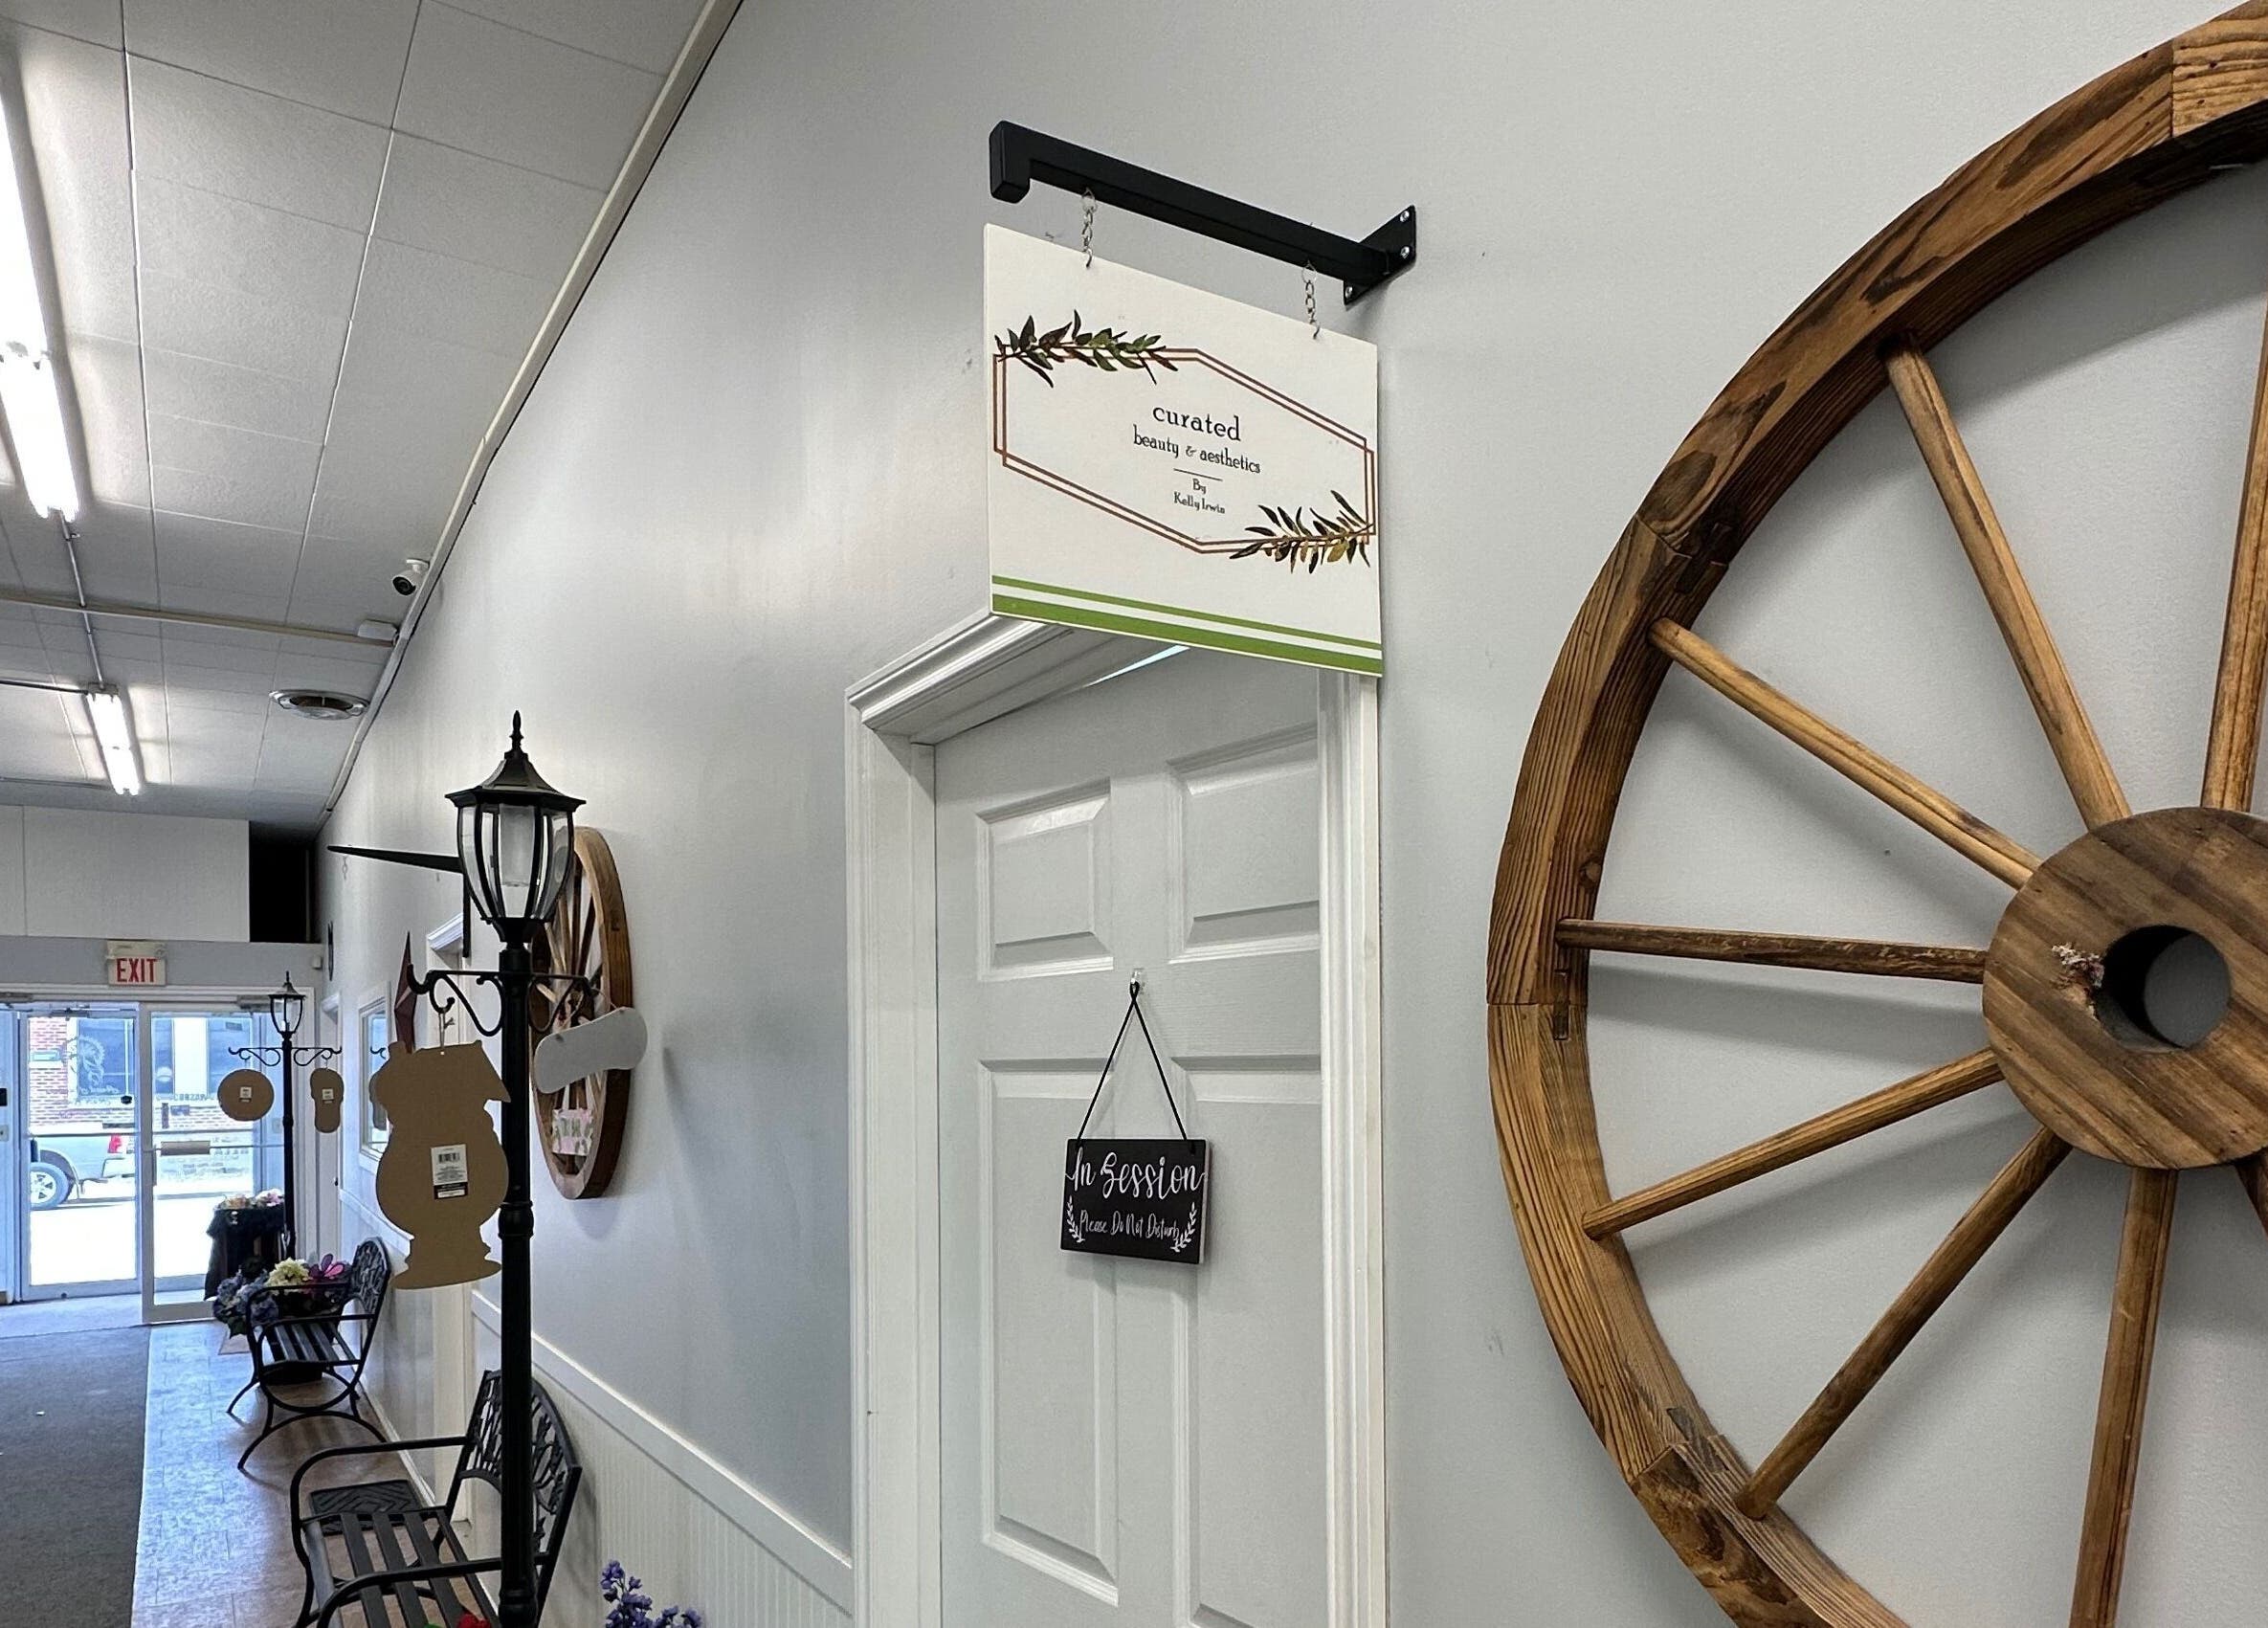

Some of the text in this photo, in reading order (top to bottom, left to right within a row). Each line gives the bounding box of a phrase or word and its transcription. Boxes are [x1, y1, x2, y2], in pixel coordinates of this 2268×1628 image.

[1152, 407, 1241, 441] curated
[1133, 424, 1261, 474] beauty & aesthetics
[1173, 491, 1200, 511] Kelly
[1192, 478, 1207, 495] By
[116, 957, 158, 983] EXIT
[1065, 1147, 1207, 1200] In Session
[1078, 1209, 1180, 1240] Please Do Not Disturb
